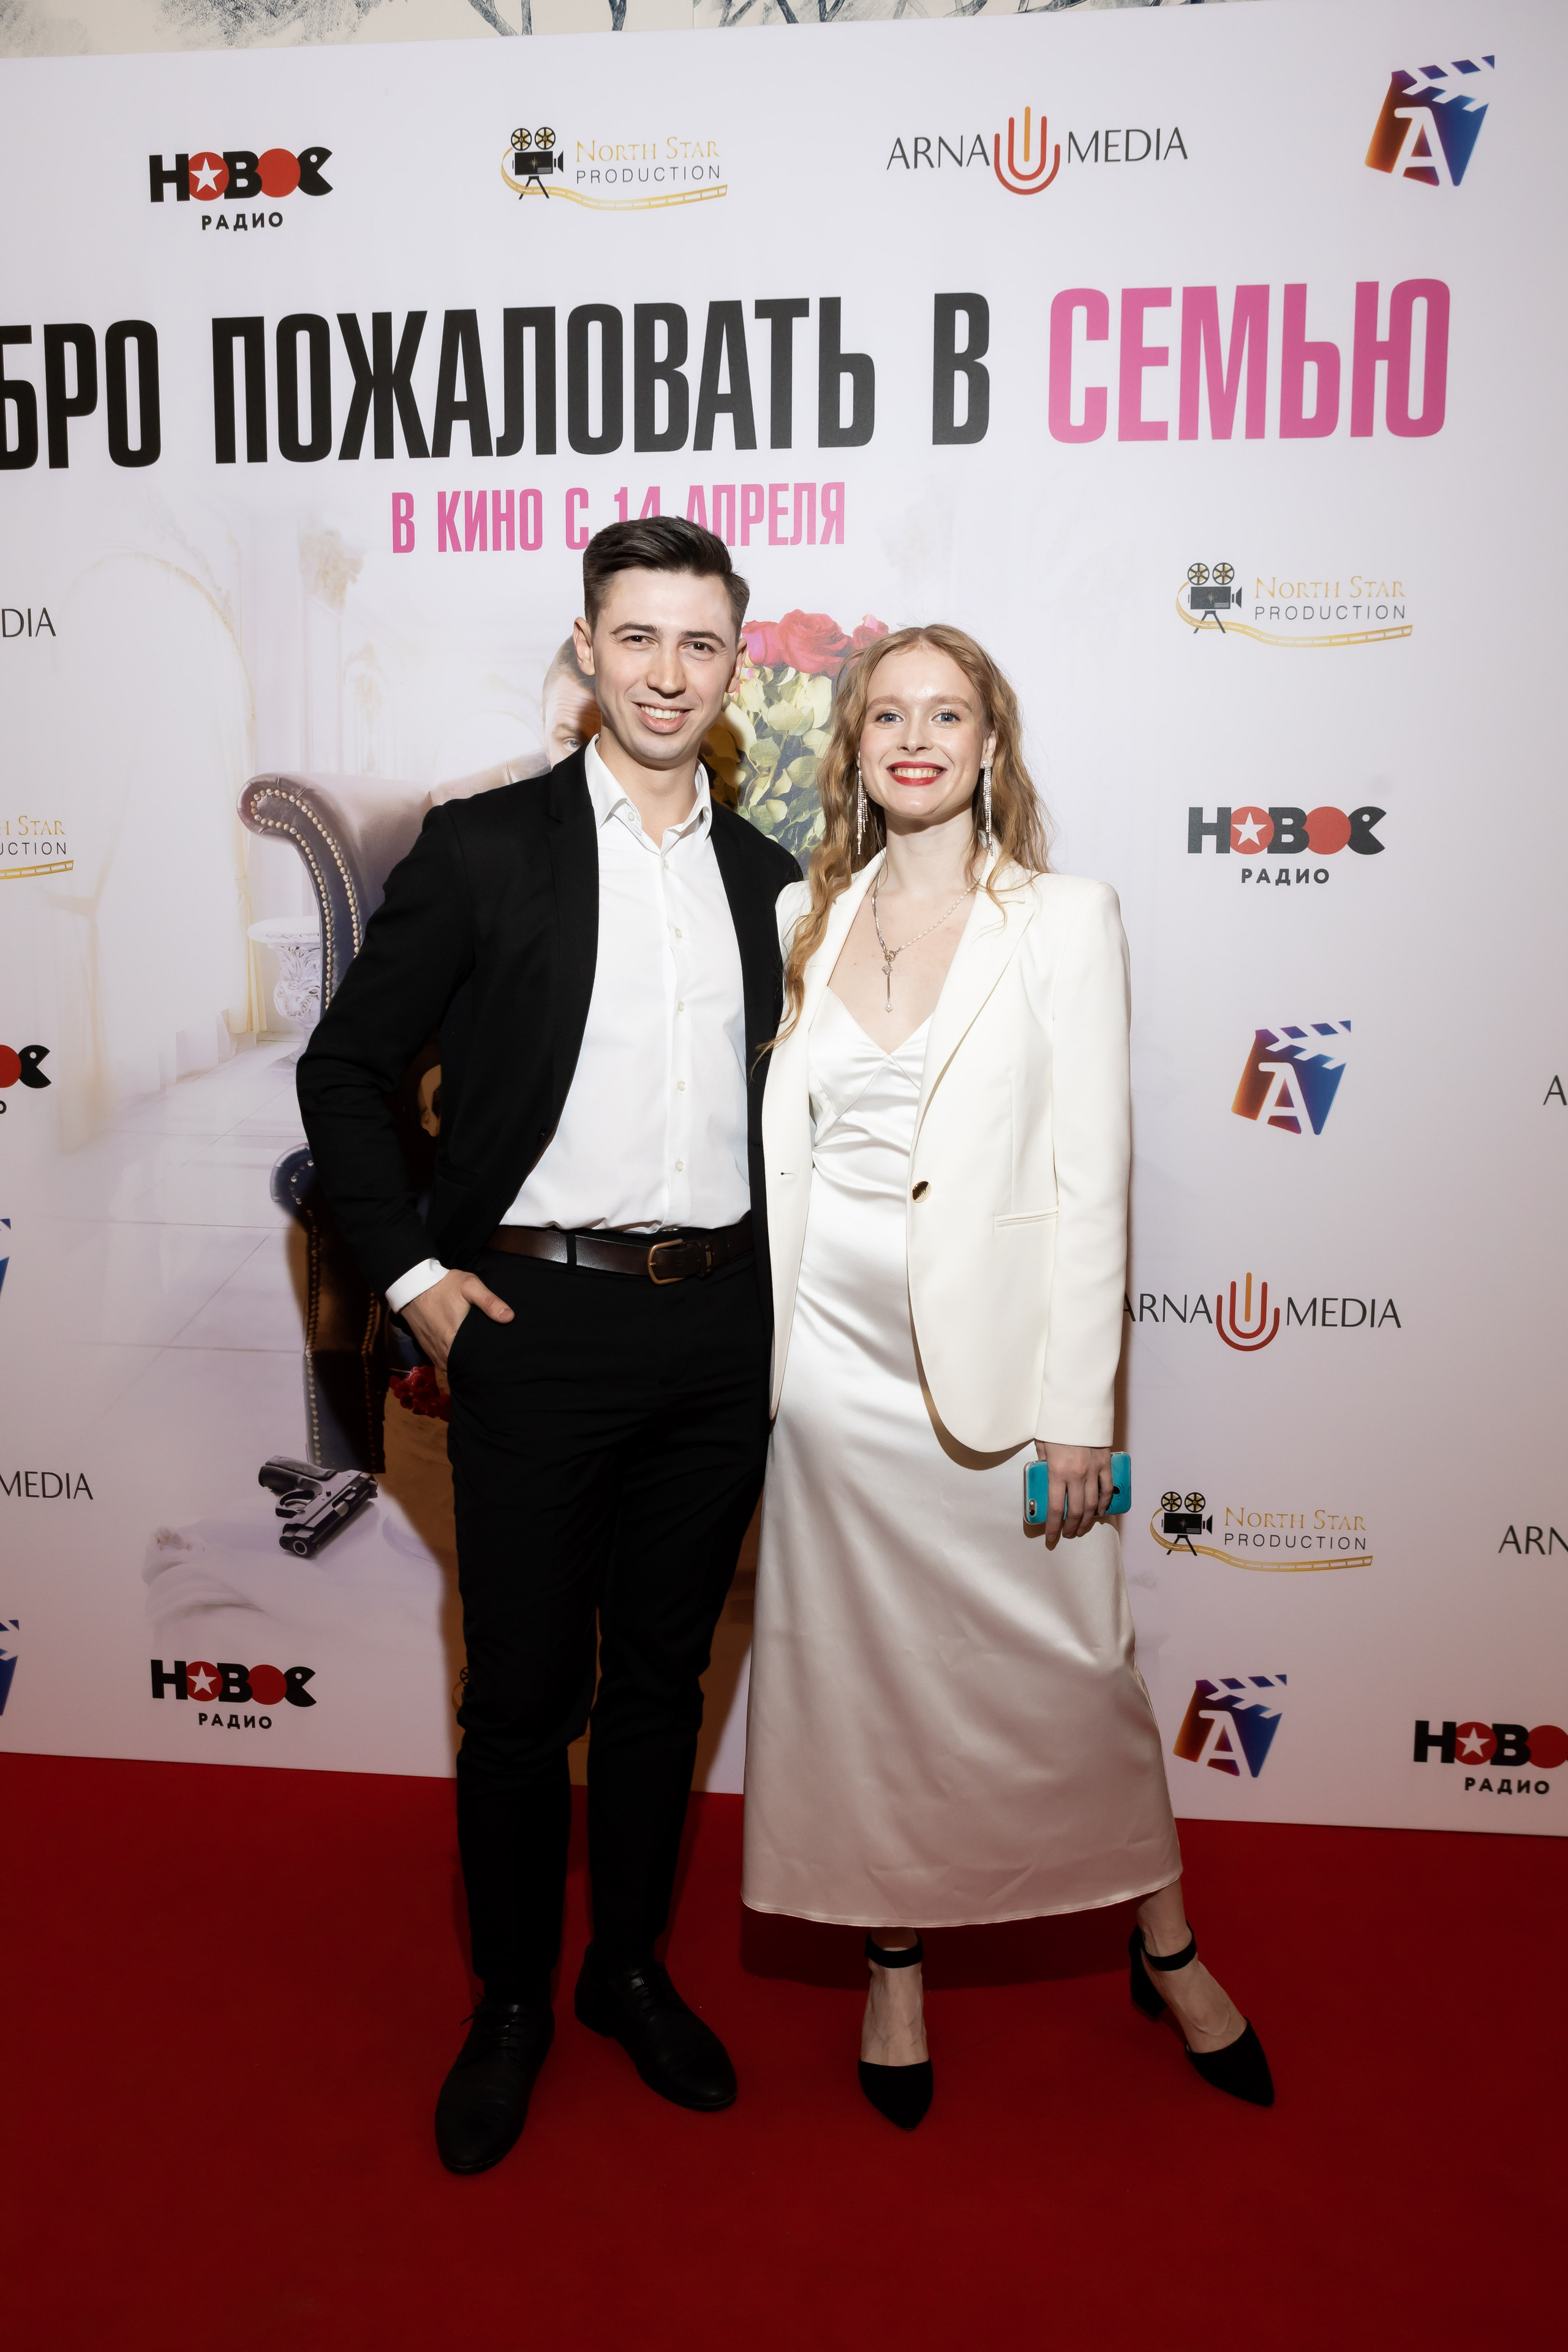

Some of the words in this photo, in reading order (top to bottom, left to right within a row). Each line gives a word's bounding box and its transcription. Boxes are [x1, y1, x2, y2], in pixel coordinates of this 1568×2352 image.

[577, 140, 656, 162] NORTH
[666, 137, 719, 159] STAR
[887, 134, 990, 170] ARNA
[1068, 127, 1188, 164] MEDIA
[576, 165, 720, 184] PRODUCTION
[202, 212, 284, 232] РАДИО
[212, 296, 875, 464] ПОЖАЛОВАТЬ
[932, 293, 990, 445] В
[1048, 278, 1450, 444] СЕМЬЮ
[392, 492, 415, 553] В
[437, 488, 543, 552] КИНО
[565, 488, 589, 550] С
[1255, 577, 1340, 599] NORTH
[1350, 576, 1406, 598] STAR
[1255, 605, 1405, 620] PRODUCTION
[18, 815, 66, 835] STAR
[1241, 869, 1329, 886] РАДИО
[1286, 1297, 1401, 1328] MEDIA
[1224, 1507, 1304, 1528] NORTH
[1314, 1510, 1366, 1531] STAR
[1224, 1533, 1366, 1550] PRODUCTION
[198, 1713, 272, 1729] РАДИО
[1464, 1777, 1550, 1795] РАДИО
